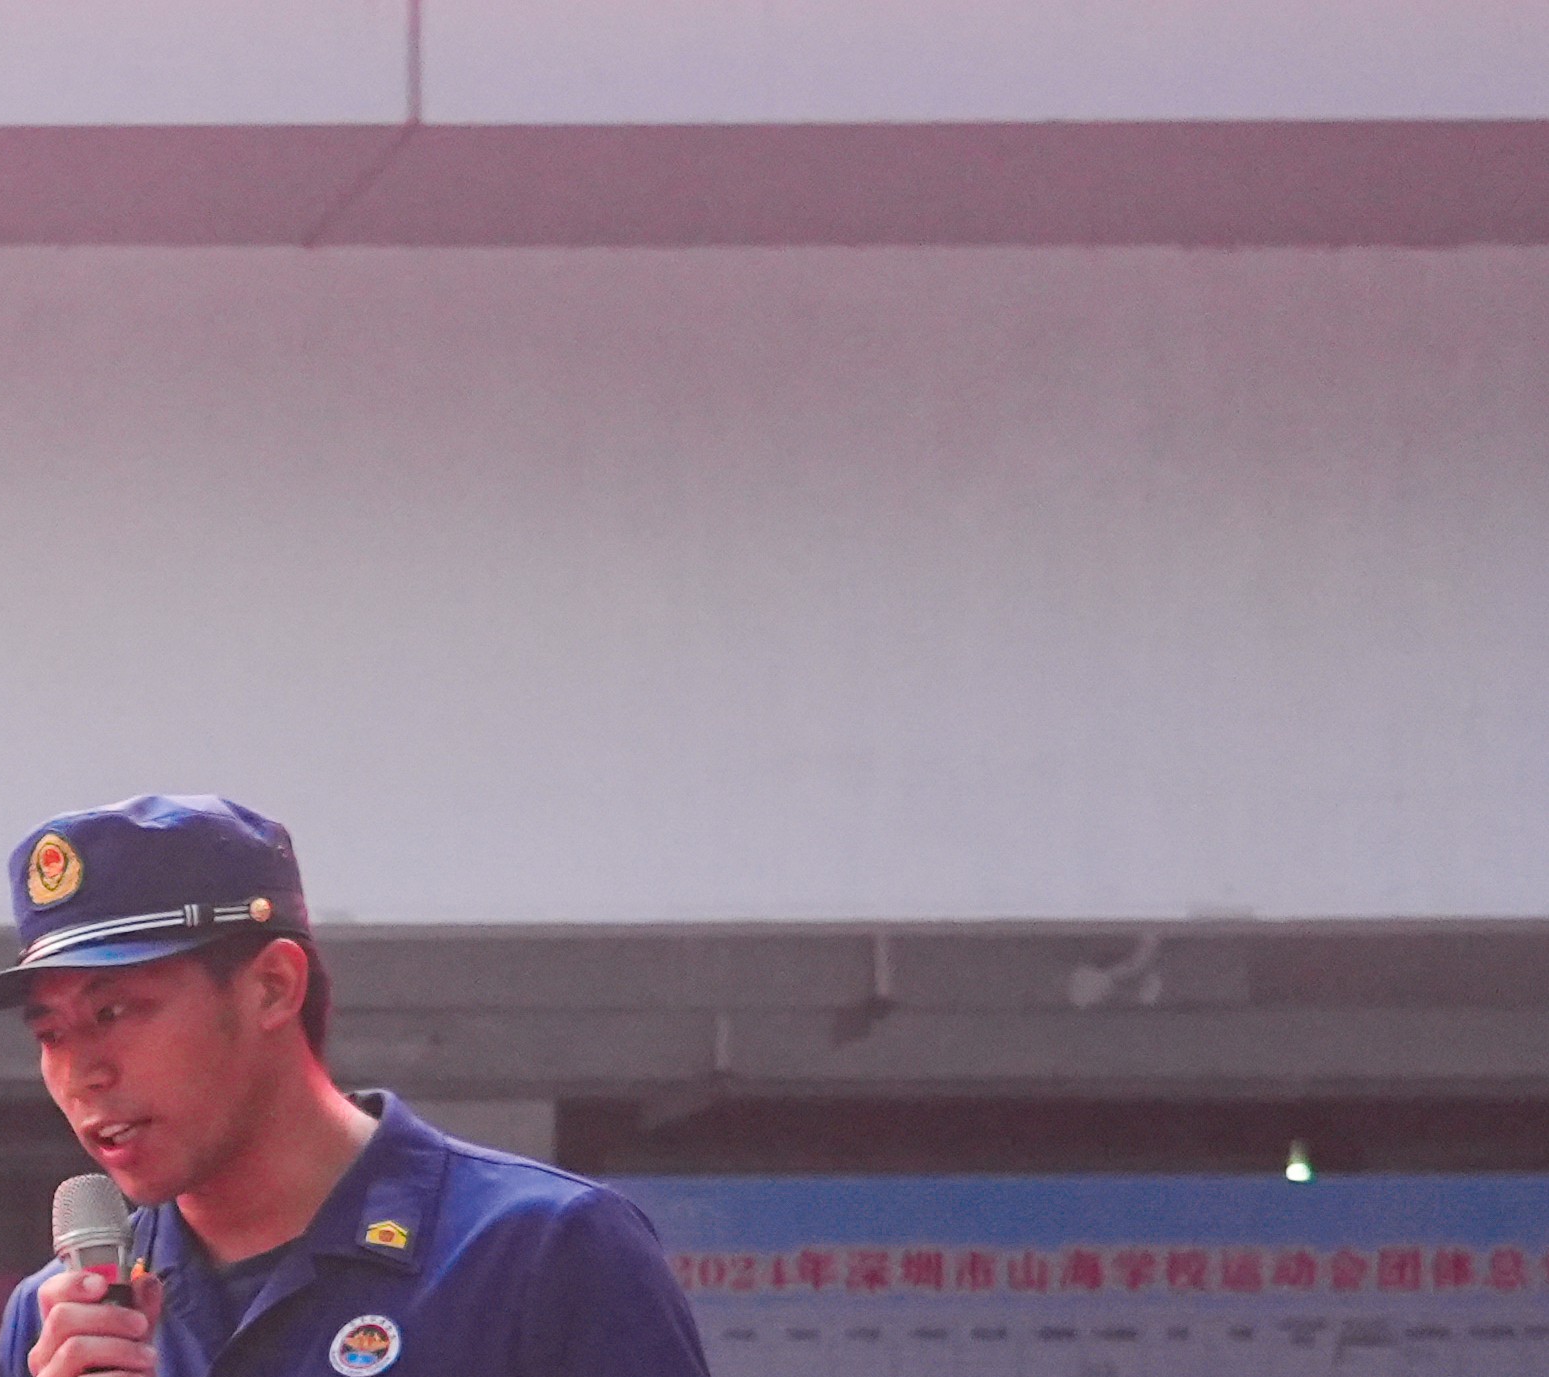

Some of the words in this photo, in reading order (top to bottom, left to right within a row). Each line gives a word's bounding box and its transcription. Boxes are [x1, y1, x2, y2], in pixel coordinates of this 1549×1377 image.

[674, 1249, 1549, 1293] 2024年深圳市山海学校运动会团体总
